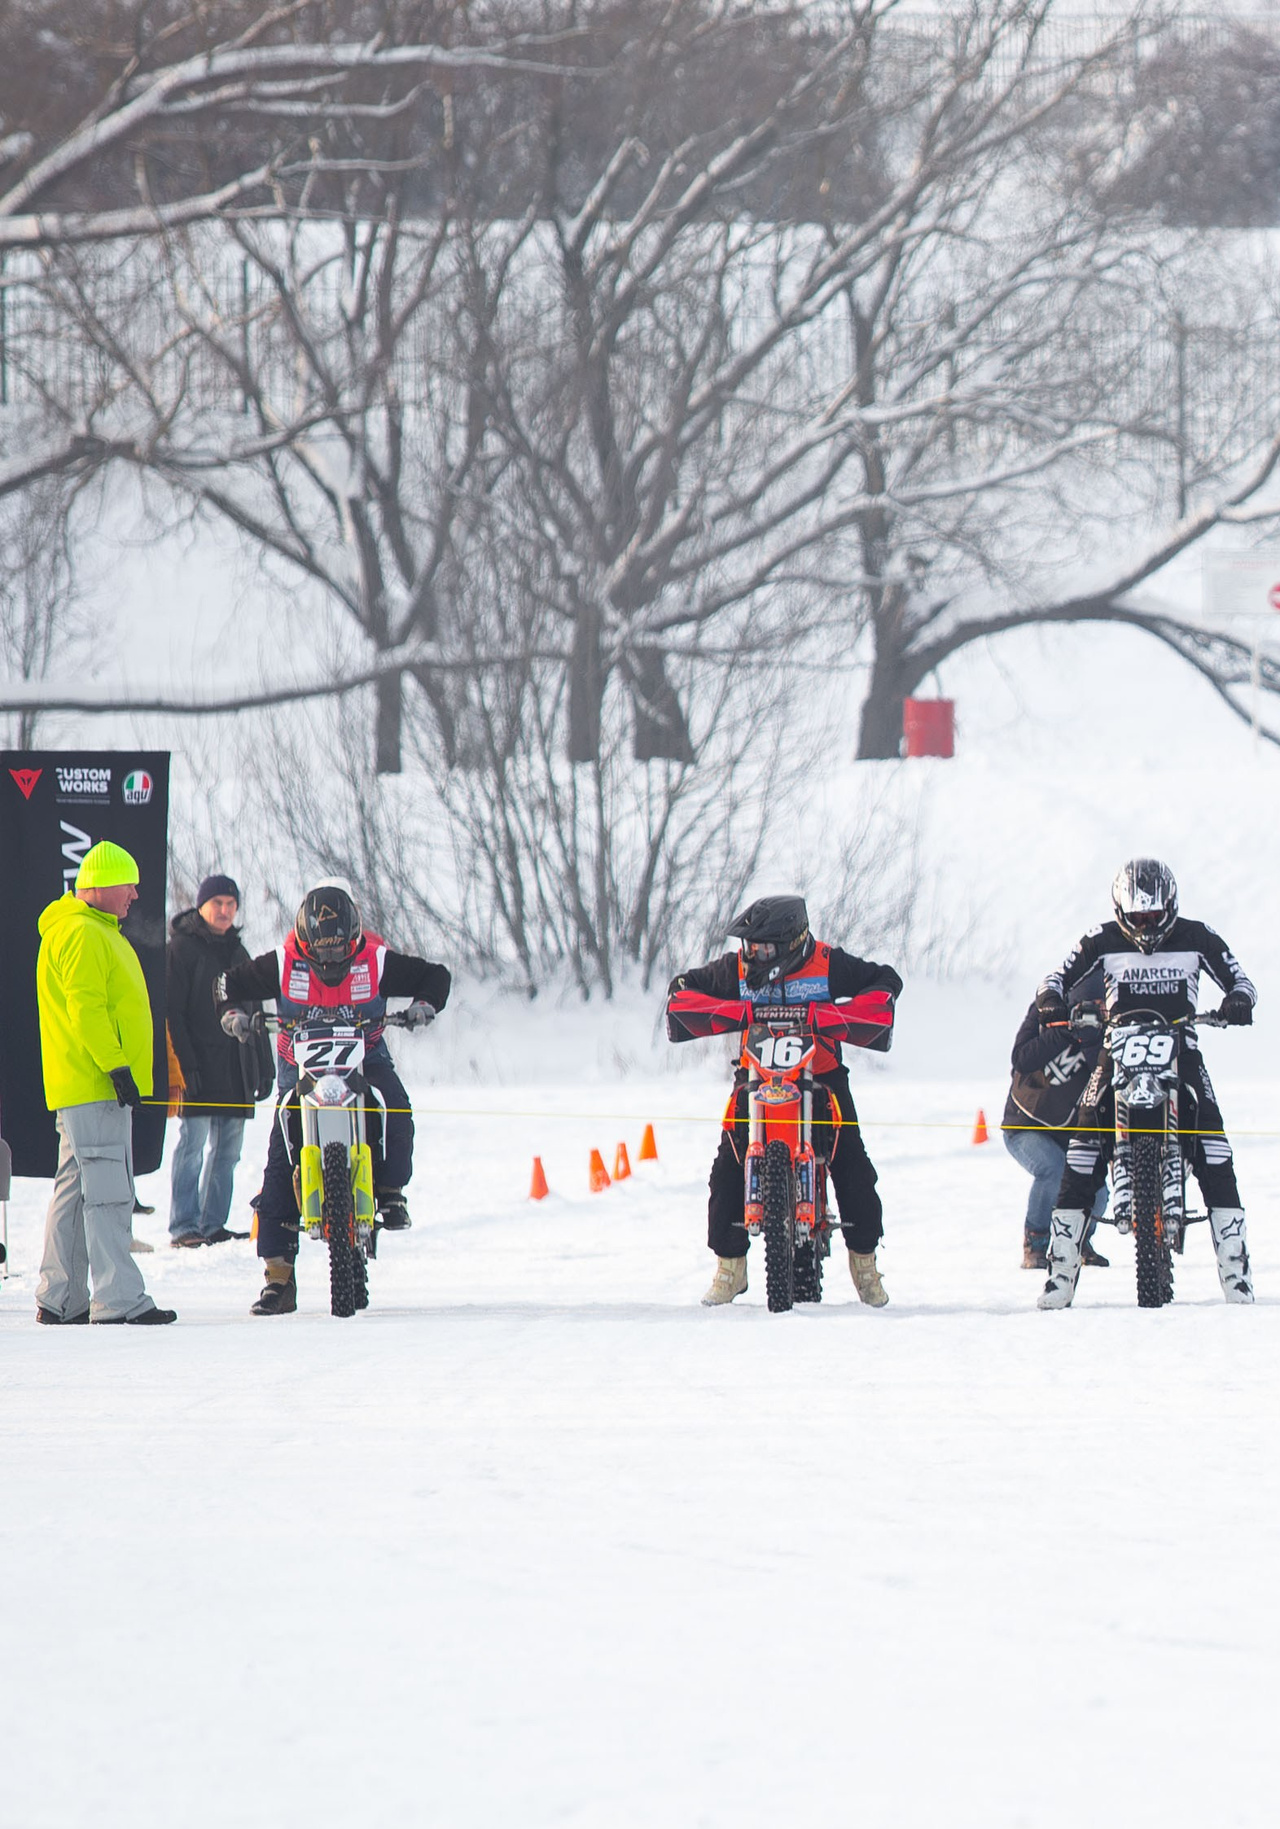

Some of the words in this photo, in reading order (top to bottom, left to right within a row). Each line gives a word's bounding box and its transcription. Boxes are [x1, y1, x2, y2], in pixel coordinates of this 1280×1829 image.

[59, 780, 108, 793] WORKS
[1122, 967, 1184, 980] ANARCHY
[1129, 980, 1179, 994] RACING
[754, 1011, 808, 1019] RENTHAL
[303, 1041, 359, 1068] 27
[755, 1036, 804, 1068] 16
[1121, 1035, 1175, 1066] 69
